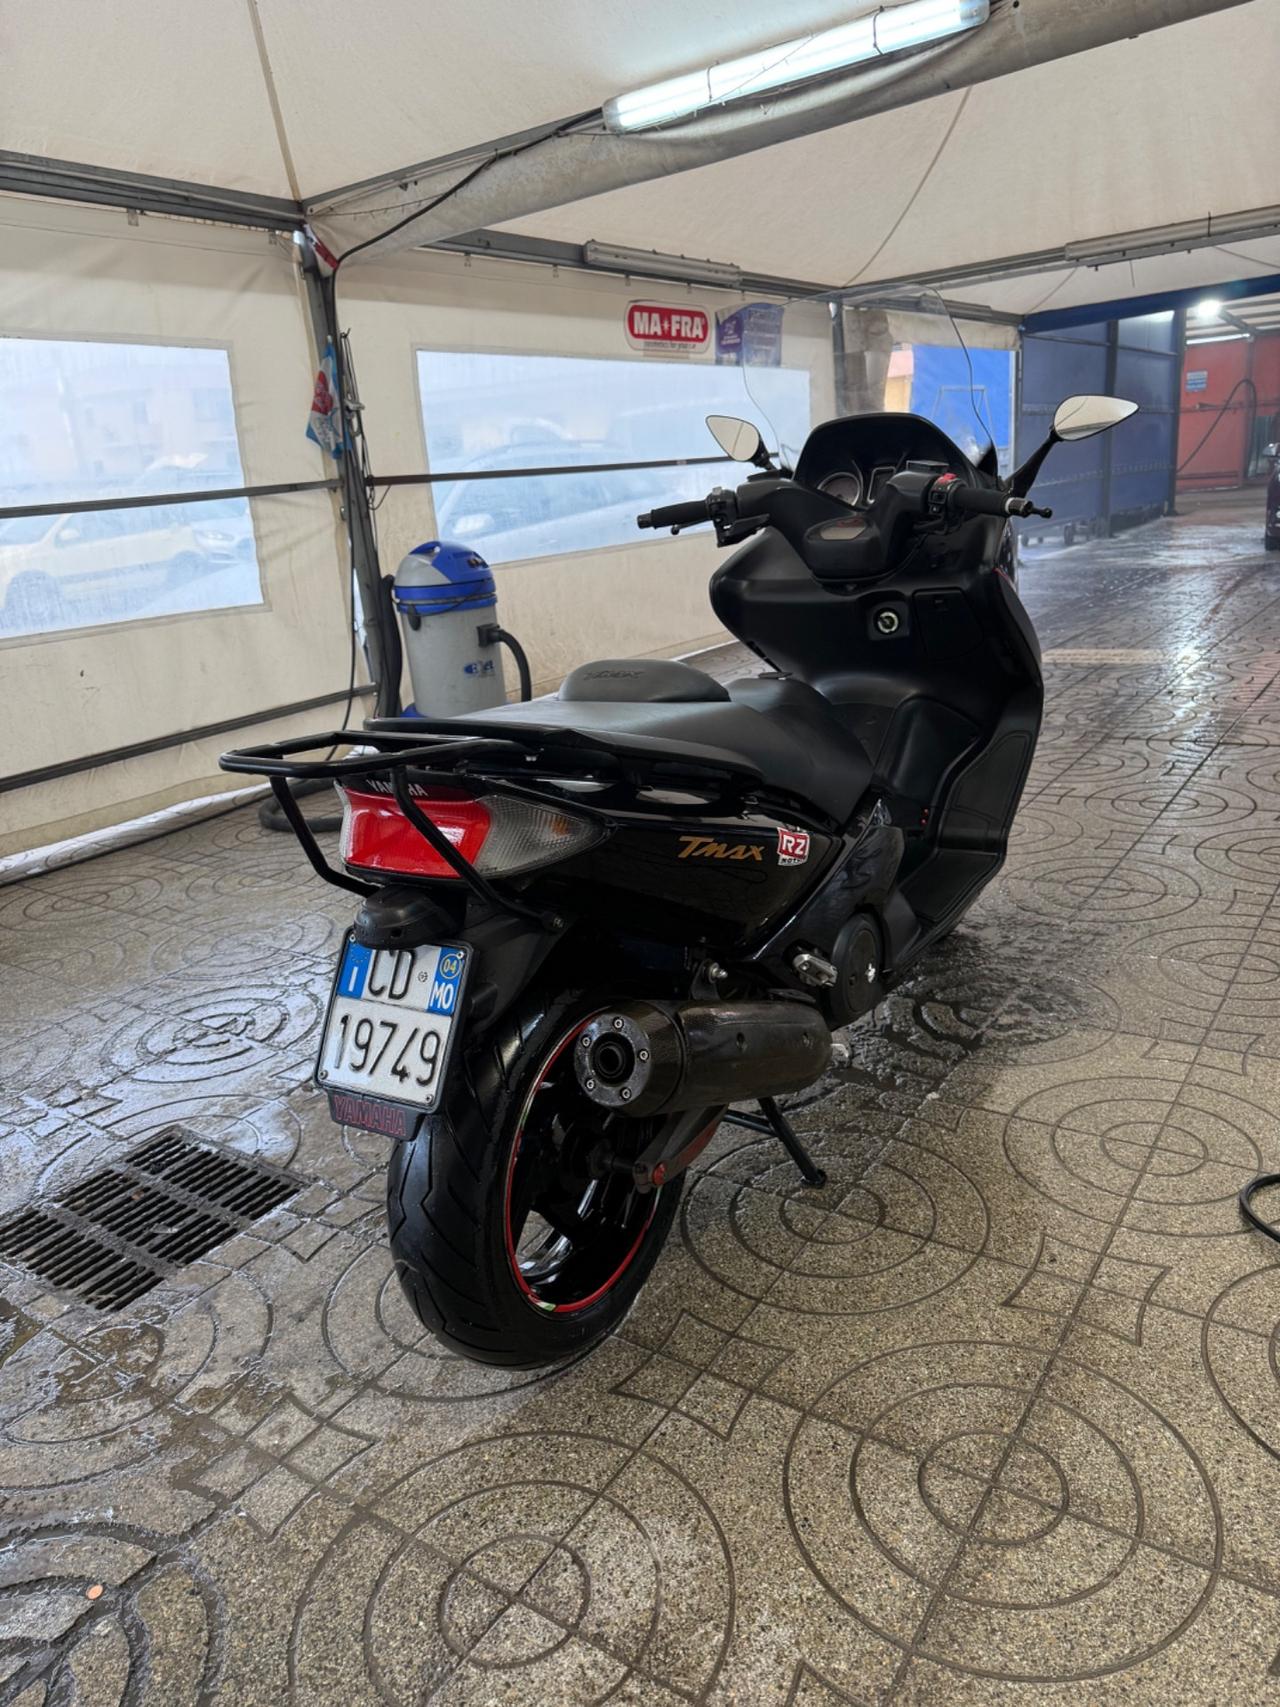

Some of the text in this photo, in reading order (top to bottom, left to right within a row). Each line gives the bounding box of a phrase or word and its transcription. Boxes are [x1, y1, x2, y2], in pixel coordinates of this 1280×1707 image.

[366, 779, 430, 796] YAMHA
[782, 834, 806, 856] RZ
[368, 948, 416, 1000] CD
[443, 958, 458, 974] 04
[429, 980, 454, 1010] MO
[335, 1014, 441, 1086] 19749
[334, 1094, 406, 1137] YAMAHA
